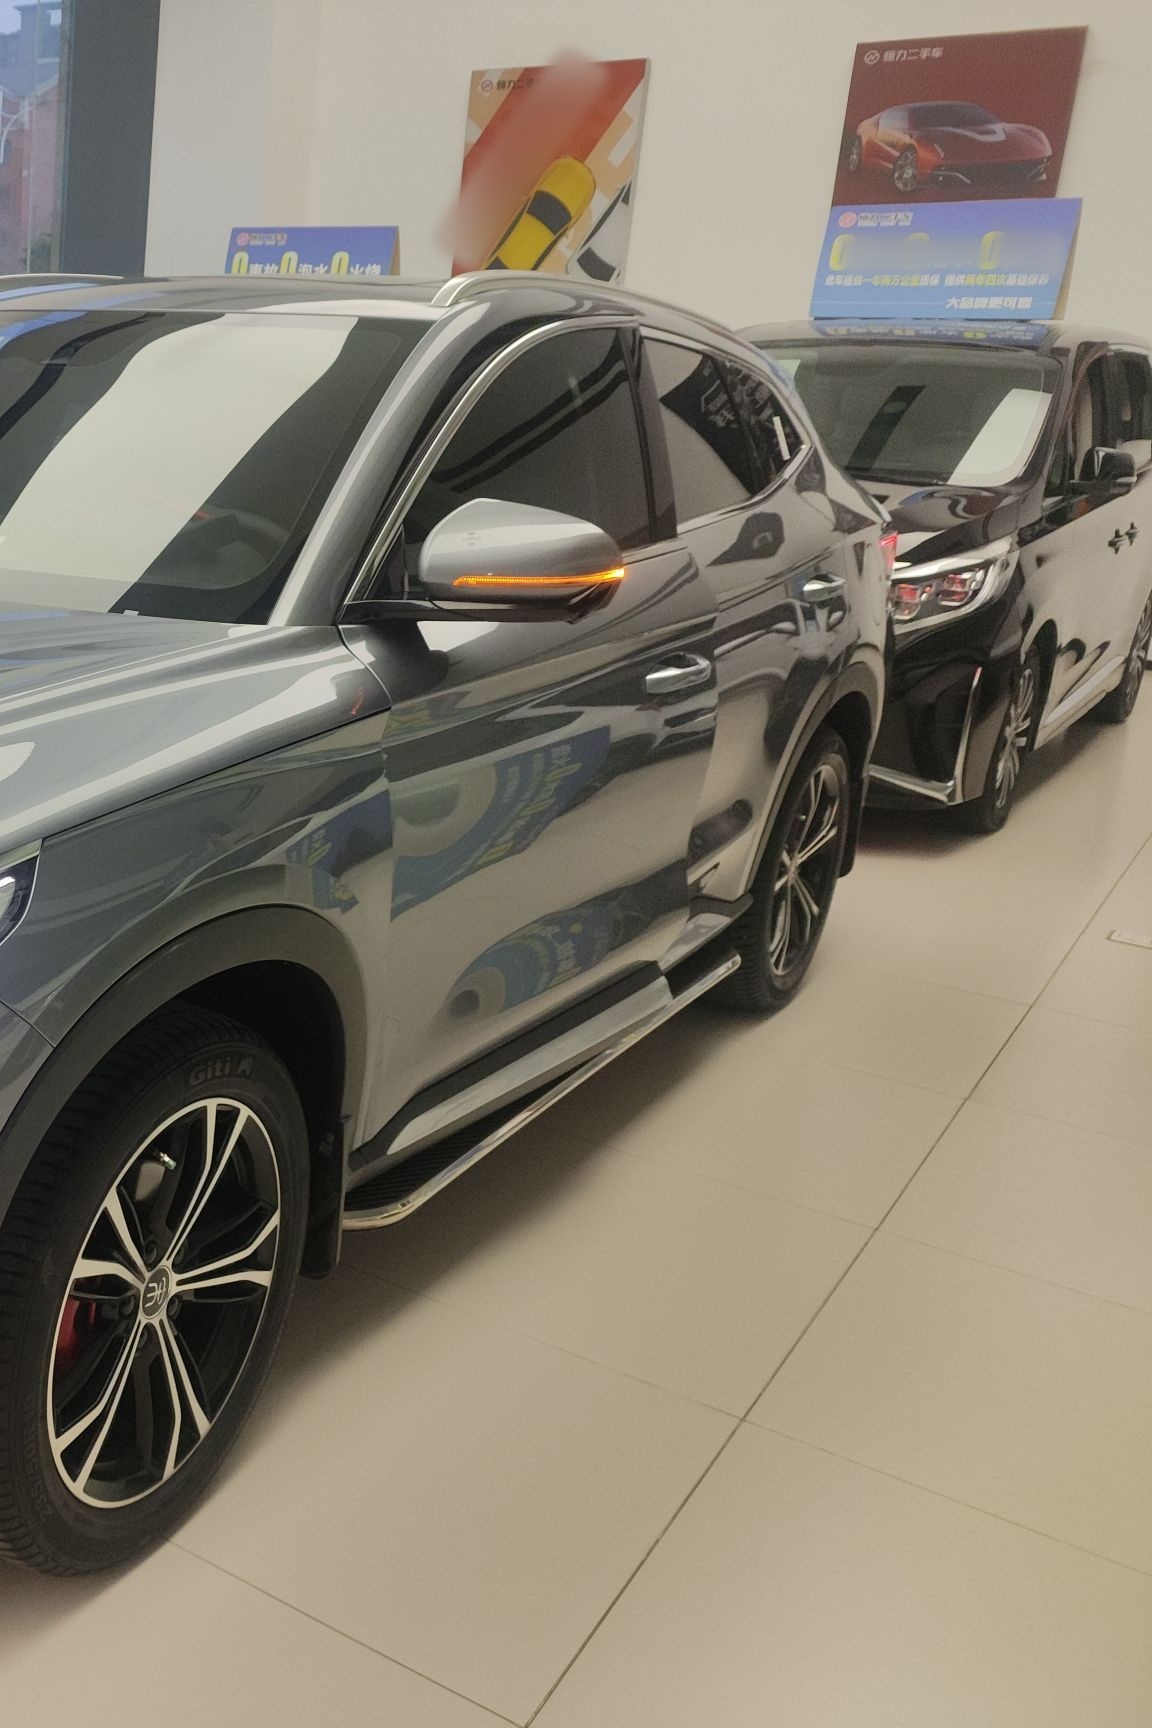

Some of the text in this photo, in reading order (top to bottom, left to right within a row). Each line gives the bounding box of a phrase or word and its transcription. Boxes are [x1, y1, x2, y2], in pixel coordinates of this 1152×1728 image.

[945, 296, 1033, 310] 大品牌更可靠
